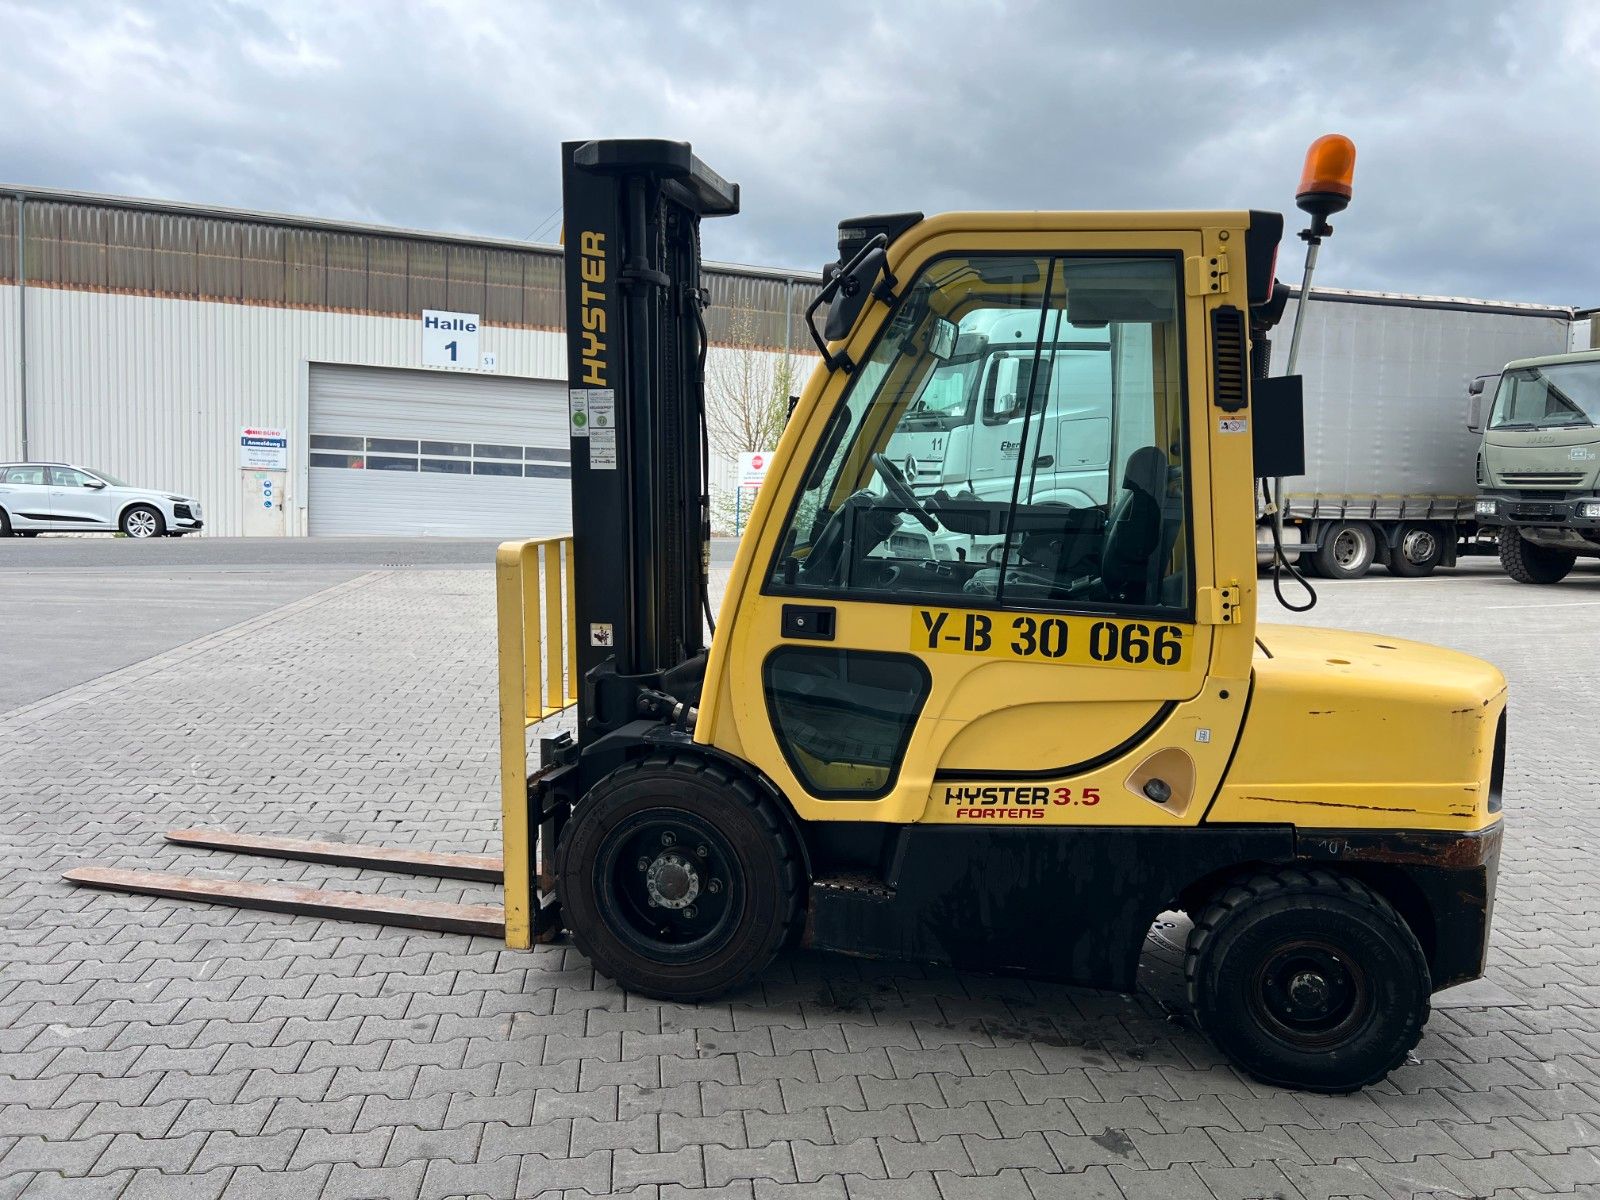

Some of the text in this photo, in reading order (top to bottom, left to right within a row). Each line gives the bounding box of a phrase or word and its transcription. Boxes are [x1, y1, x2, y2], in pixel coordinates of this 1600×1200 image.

[581, 230, 606, 387] HYSTER
[425, 316, 476, 332] Halle
[444, 341, 457, 361] 1
[931, 438, 943, 451] 11
[920, 611, 1183, 666] Y-B 30 066
[945, 787, 1101, 806] HYSTER 3.5
[956, 808, 1045, 819] FORTENS
